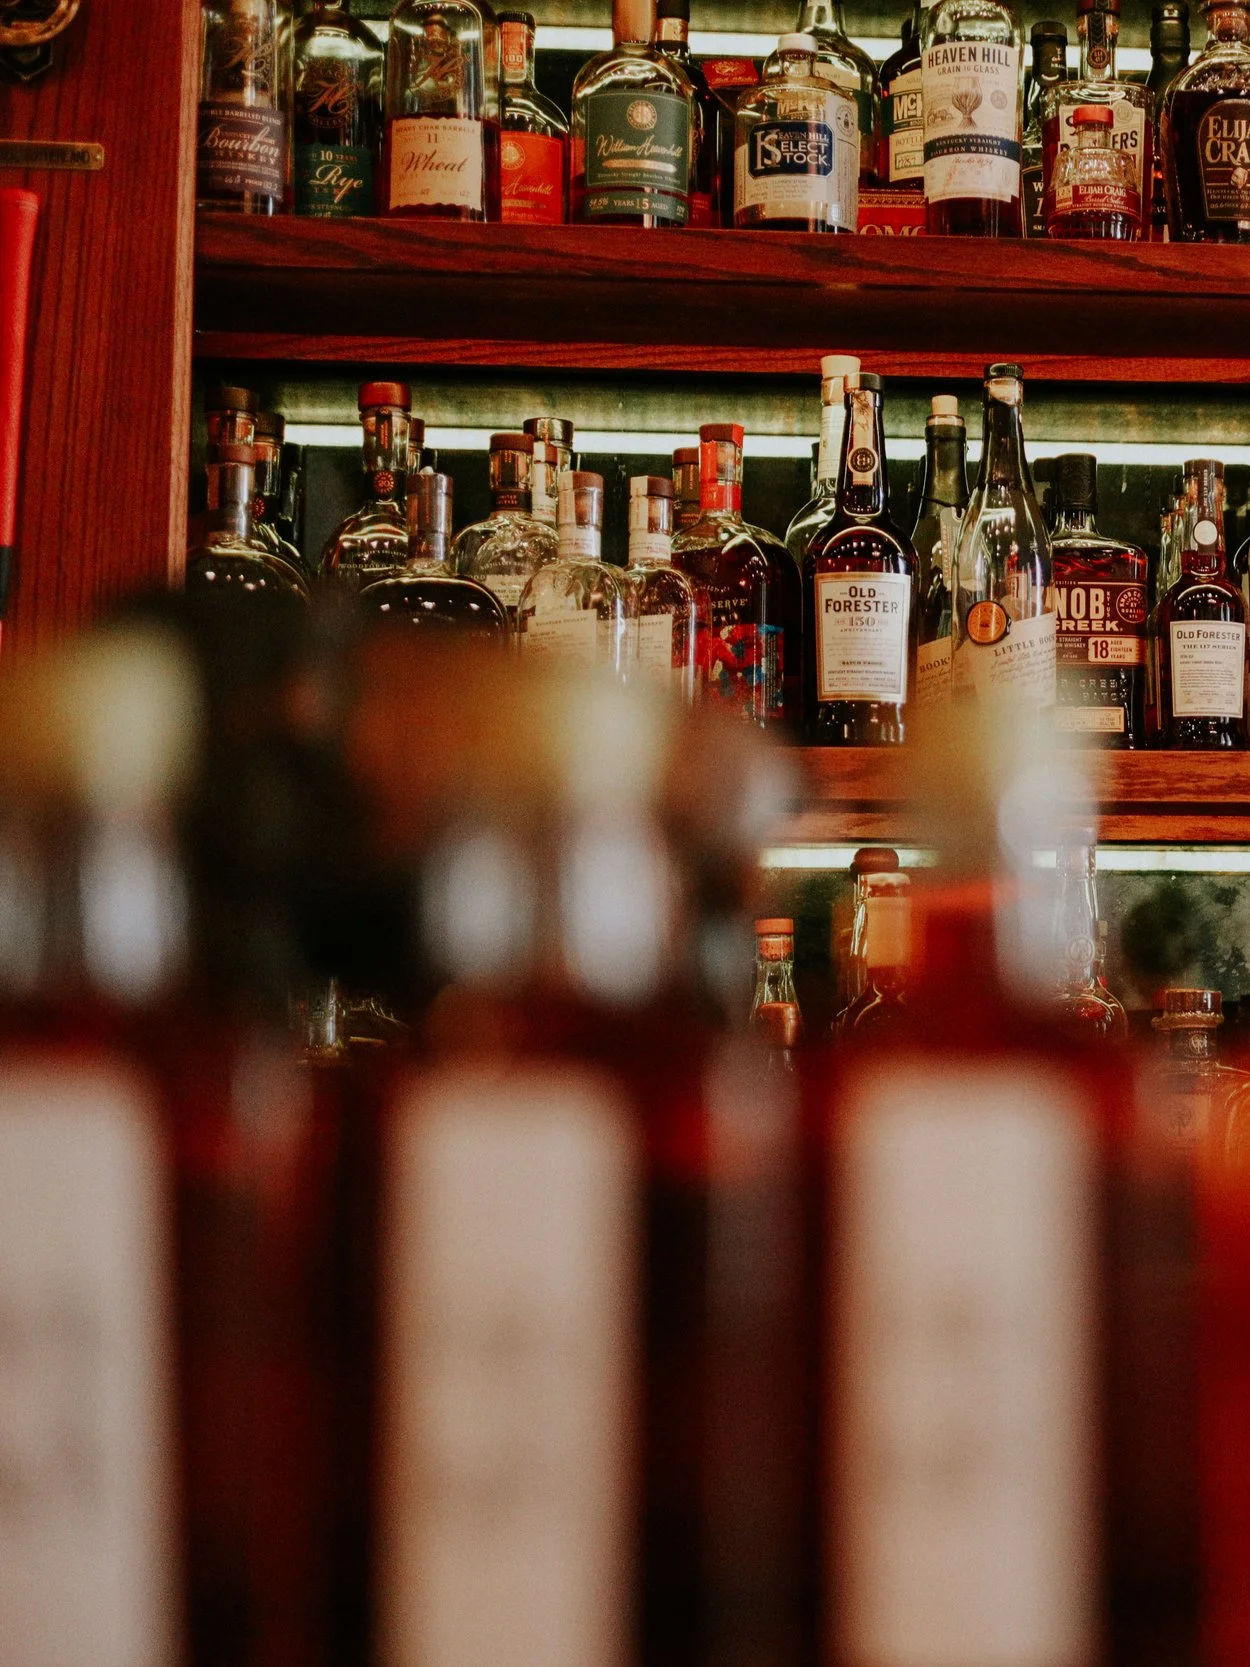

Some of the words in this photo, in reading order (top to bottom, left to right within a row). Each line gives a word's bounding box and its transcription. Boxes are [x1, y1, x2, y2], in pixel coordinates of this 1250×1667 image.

[928, 47, 977, 68] HEAVEN
[982, 50, 1011, 68] HILL
[937, 66, 961, 75] GRAIN
[974, 65, 1000, 75] GLASS
[204, 123, 280, 158] Bourbon
[808, 131, 830, 144] HILL
[968, 136, 1001, 146] STRAIGHT
[320, 150, 333, 162] 10
[969, 145, 1009, 157] WHISKEY
[404, 150, 468, 174] Wheat
[309, 164, 364, 205] Rye
[1078, 185, 1104, 195] ELIJAH
[1104, 185, 1127, 197] CRAIG
[613, 199, 635, 207] YEARS
[635, 198, 650, 210] 15
[651, 202, 669, 211] AGED
[848, 585, 876, 598] OLD
[711, 597, 748, 610] SERVE
[825, 598, 899, 614] FORESTER
[1055, 587, 1105, 620] NOB
[1176, 630, 1195, 640] OLD
[1196, 629, 1241, 641] FORESTER
[993, 638, 1036, 657] LITTLE
[1091, 639, 1109, 659] 18
